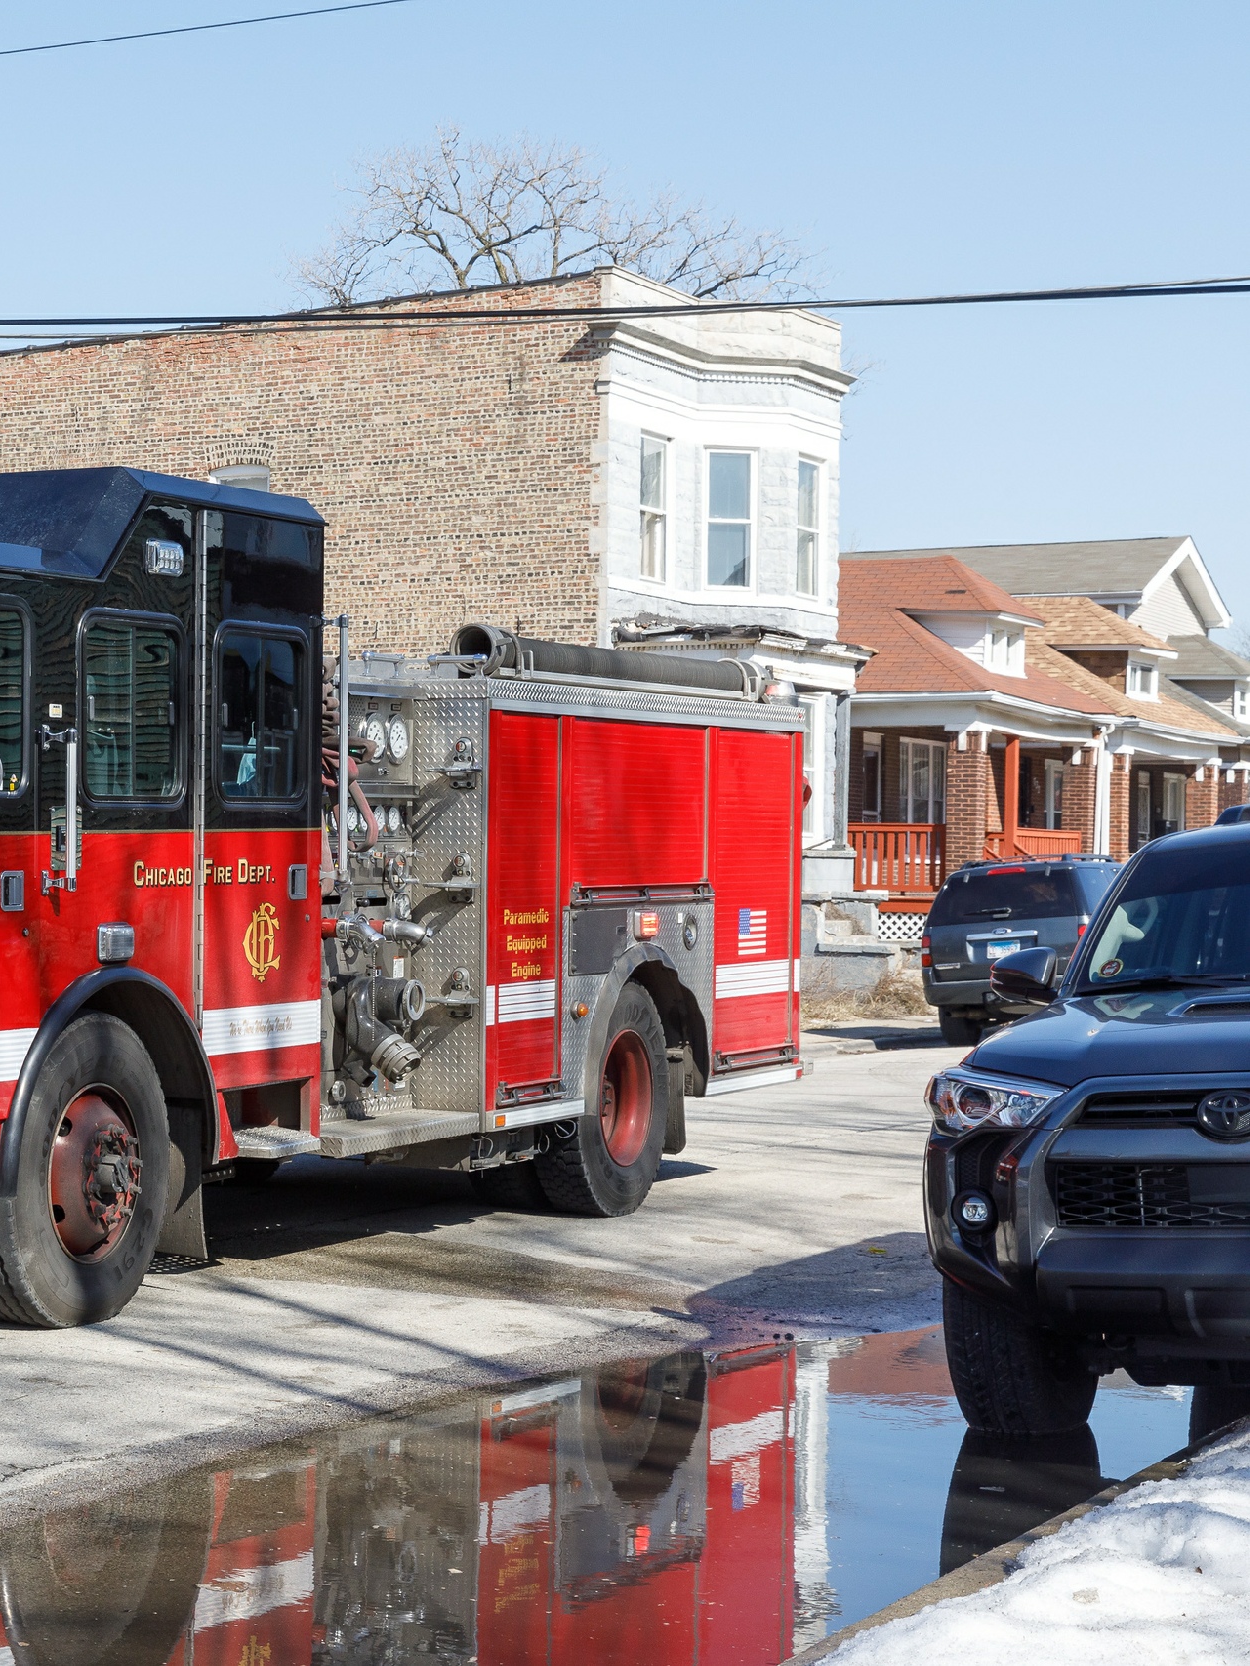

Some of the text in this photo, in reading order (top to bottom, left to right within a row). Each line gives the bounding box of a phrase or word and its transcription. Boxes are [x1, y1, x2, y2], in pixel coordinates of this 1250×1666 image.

[133, 857, 276, 888] CHICAGO FIRE DEPT.
[503, 908, 550, 925] Paramedic
[507, 934, 547, 955] Equipped
[511, 961, 541, 980] Engine
